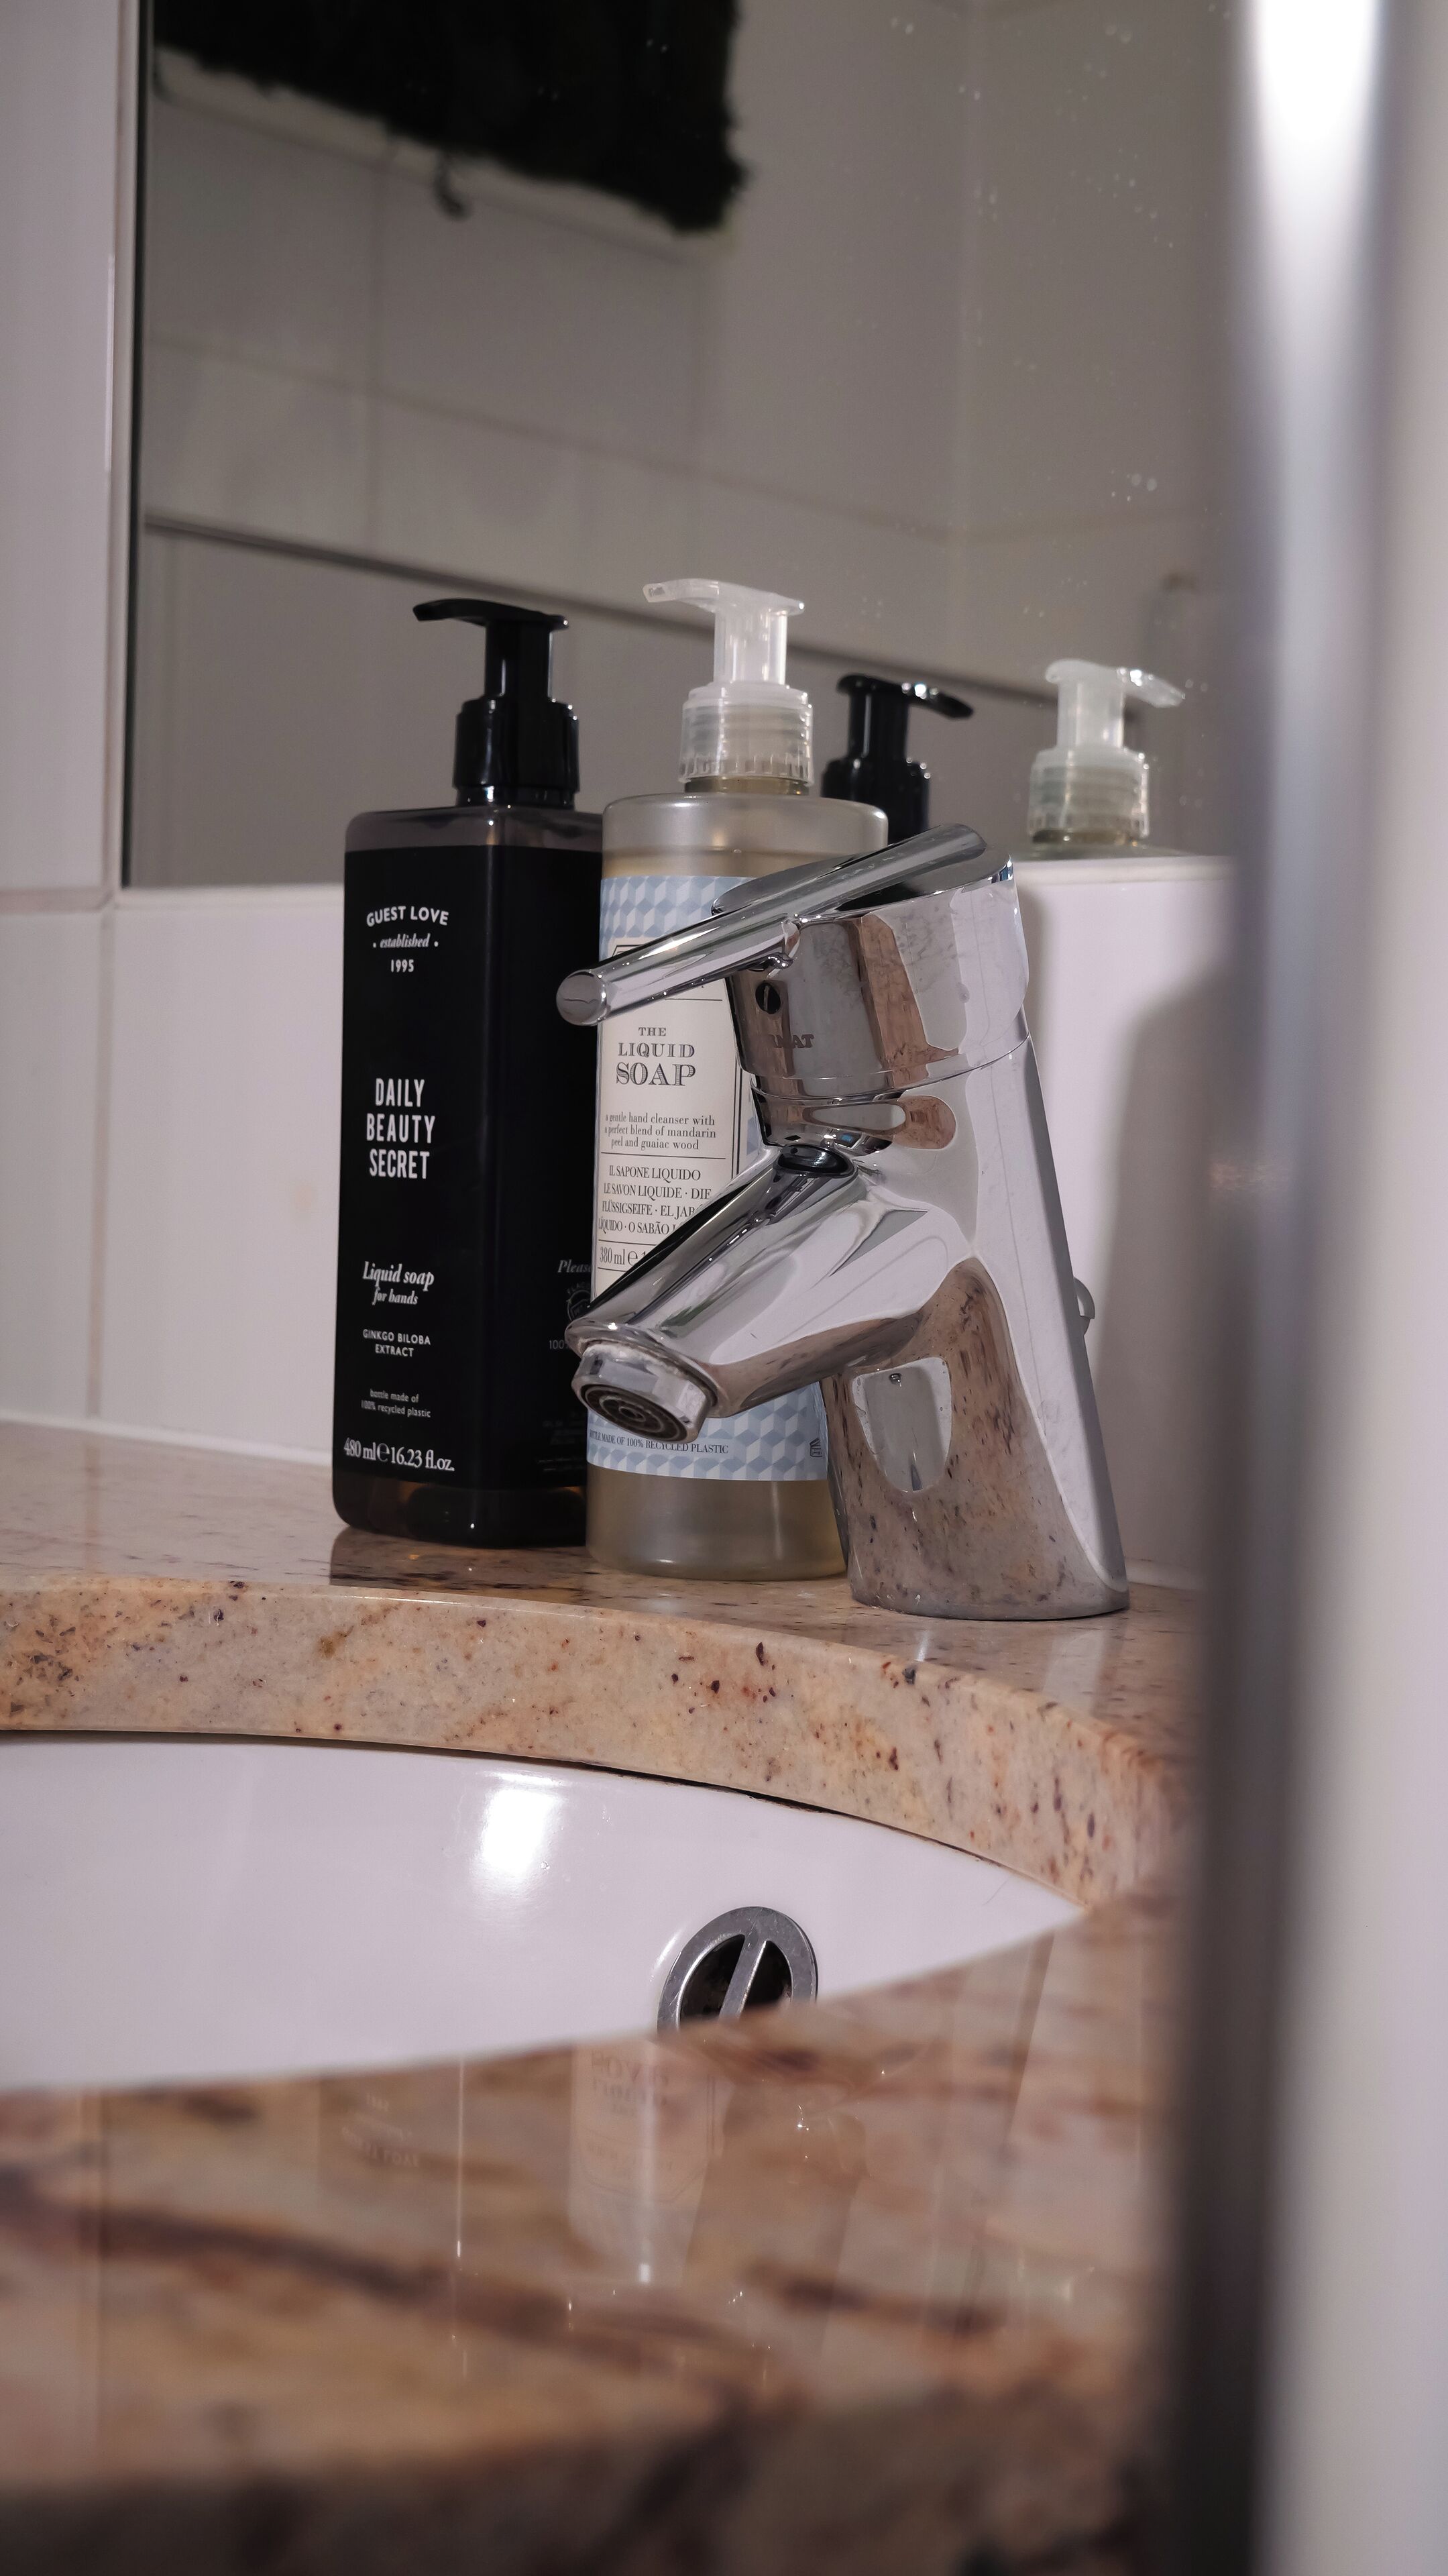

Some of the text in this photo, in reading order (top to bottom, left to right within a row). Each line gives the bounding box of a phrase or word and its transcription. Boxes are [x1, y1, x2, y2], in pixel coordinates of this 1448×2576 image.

[366, 906, 449, 927] GUEST LOVE
[380, 933, 431, 949] established
[391, 959, 414, 973] 1995
[638, 1026, 667, 1036] THE
[618, 1042, 695, 1058] LIQUID
[616, 1061, 696, 1087] SOAP
[375, 1078, 425, 1108] DAILY
[609, 1112, 627, 1124] gentle
[628, 1112, 648, 1123] hand
[651, 1113, 689, 1124] cleanser
[693, 1115, 715, 1126] with
[366, 1113, 435, 1144] BEAUTY
[608, 1124, 628, 1137] perfect
[630, 1124, 653, 1136] blend
[655, 1126, 665, 1136] of
[667, 1126, 716, 1138] mandarin
[611, 1136, 700, 1150] peel and guaiac wood
[369, 1148, 430, 1179] SECRET
[609, 1165, 701, 1183] IL SAPONE LIQUIDO
[604, 1183, 611, 1193] LE
[611, 1183, 636, 1196] SAVON
[638, 1185, 682, 1201] LIQUIDE
[602, 1199, 653, 1216] FLÜSSIGSEIFE
[661, 1205, 674, 1217] EL
[628, 1222, 636, 1233] O
[637, 1221, 669, 1235] SABÃO
[600, 1246, 613, 1264] 380
[614, 1248, 625, 1265] ml
[362, 1261, 435, 1291] Liquid soap
[372, 1287, 419, 1305] for hands
[363, 1329, 431, 1345] GINKGO BILOBA
[376, 1344, 414, 1356] EXTRACT
[390, 1392, 409, 1402] made
[411, 1394, 419, 1403] of
[378, 1405, 405, 1415] recycled
[407, 1407, 431, 1417] plastic
[601, 1433, 616, 1444] MADE
[616, 1436, 626, 1445] OF
[627, 1437, 644, 1448] 100%
[645, 1440, 689, 1452] RECYCLED
[691, 1444, 729, 1454] PLASTIC
[343, 1437, 361, 1458] 480
[362, 1442, 376, 1460] ml
[390, 1446, 423, 1468] 16.23
[425, 1449, 455, 1471] fl.oz.
